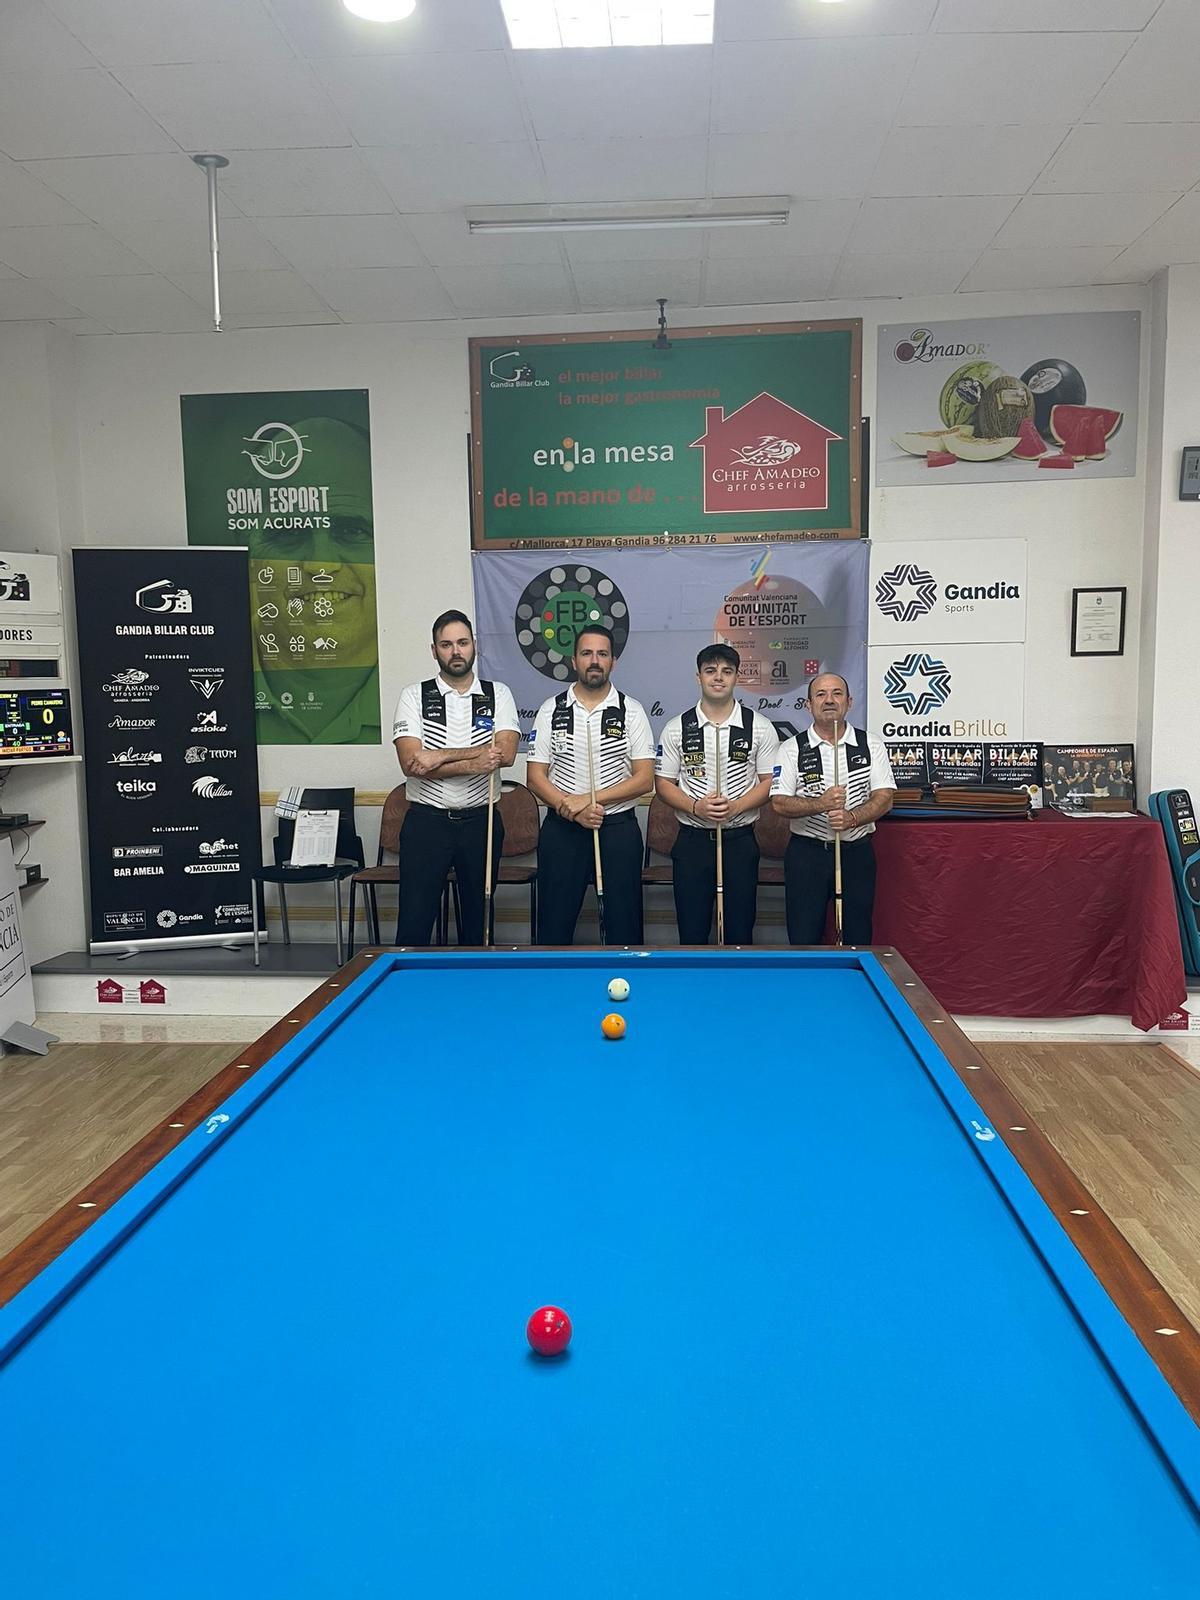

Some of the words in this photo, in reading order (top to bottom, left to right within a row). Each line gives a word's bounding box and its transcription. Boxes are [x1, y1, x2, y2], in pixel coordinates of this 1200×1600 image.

[559, 370, 570, 383] el
[576, 371, 620, 384] mejor
[490, 381, 515, 389] Gandia
[559, 392, 571, 405] la
[576, 392, 620, 406] mejor
[533, 448, 564, 466] en
[574, 442, 595, 465] la
[605, 444, 674, 464] mesa
[712, 467, 749, 483] CHEF
[754, 466, 820, 480] AMADEO
[726, 480, 806, 493] arrosseria
[226, 488, 263, 514] SOM
[269, 486, 330, 514] ESPORT
[494, 488, 522, 508] de
[528, 487, 548, 506] la
[555, 490, 621, 505] mano
[628, 484, 656, 504] de
[228, 518, 259, 530] SOM
[263, 516, 331, 530] ACURATS
[523, 540, 569, 549] Mallorca,
[586, 538, 612, 548] Playa
[615, 536, 650, 546] Gandia
[652, 536, 664, 545] 96
[668, 535, 686, 544] 284
[688, 536, 700, 544] 21
[704, 534, 716, 543] 76
[944, 582, 1020, 600] Gandia
[556, 600, 588, 623] FB
[724, 602, 798, 614] COMUNITAT
[944, 604, 974, 613] Sports
[729, 616, 744, 626] DE
[749, 614, 807, 626] L'ESPORT
[116, 625, 152, 636] GANDIA
[155, 625, 188, 636] BILLAR
[190, 625, 214, 636] CLUB
[650, 700, 664, 716] la
[43, 708, 54, 724] 0
[932, 749, 982, 760] BILLAR
[990, 749, 1038, 760] BILLAR
[116, 780, 156, 792] teika
[114, 868, 131, 876] BAR
[133, 867, 164, 876] AMELIA
[192, 864, 239, 872] MAQUINAL
